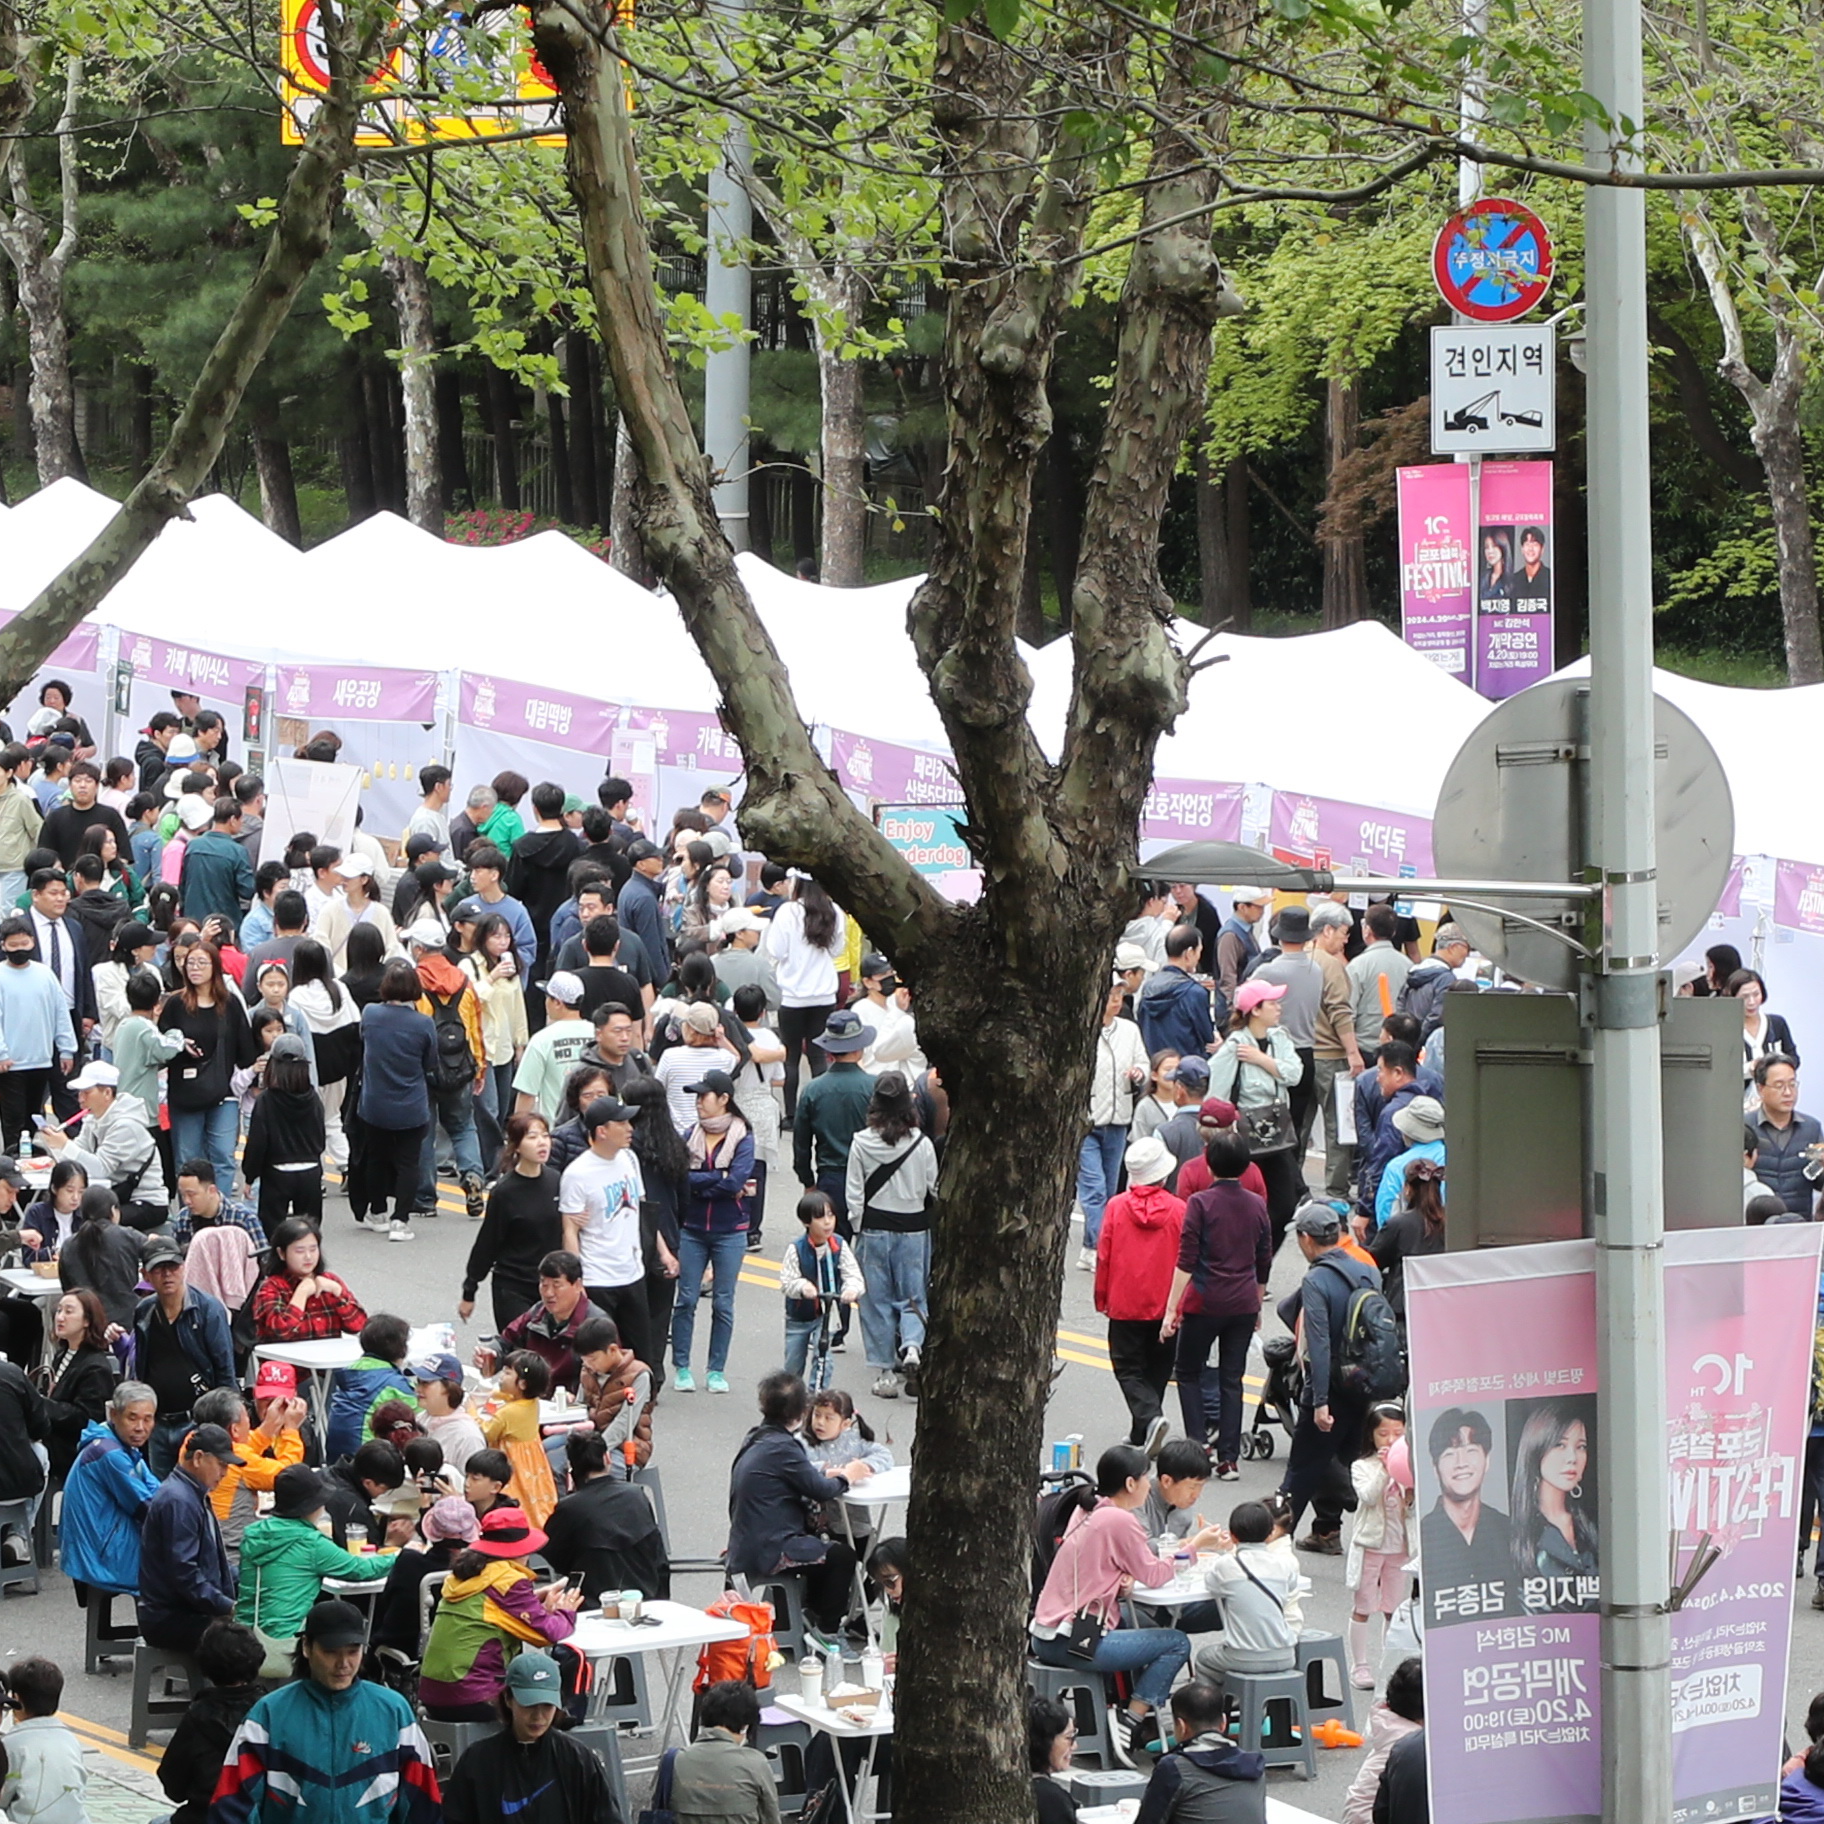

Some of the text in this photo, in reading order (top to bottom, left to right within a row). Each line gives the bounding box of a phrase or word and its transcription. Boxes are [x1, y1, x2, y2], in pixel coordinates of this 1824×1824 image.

[1444, 343, 1543, 378] 견인지역
[1488, 632, 1538, 649] 개막공연
[333, 678, 382, 708] 새우공장
[525, 699, 572, 735] 대림떡방
[885, 819, 933, 841] Enjoy
[1360, 821, 1406, 862] 언더독
[898, 845, 964, 867] nderdog
